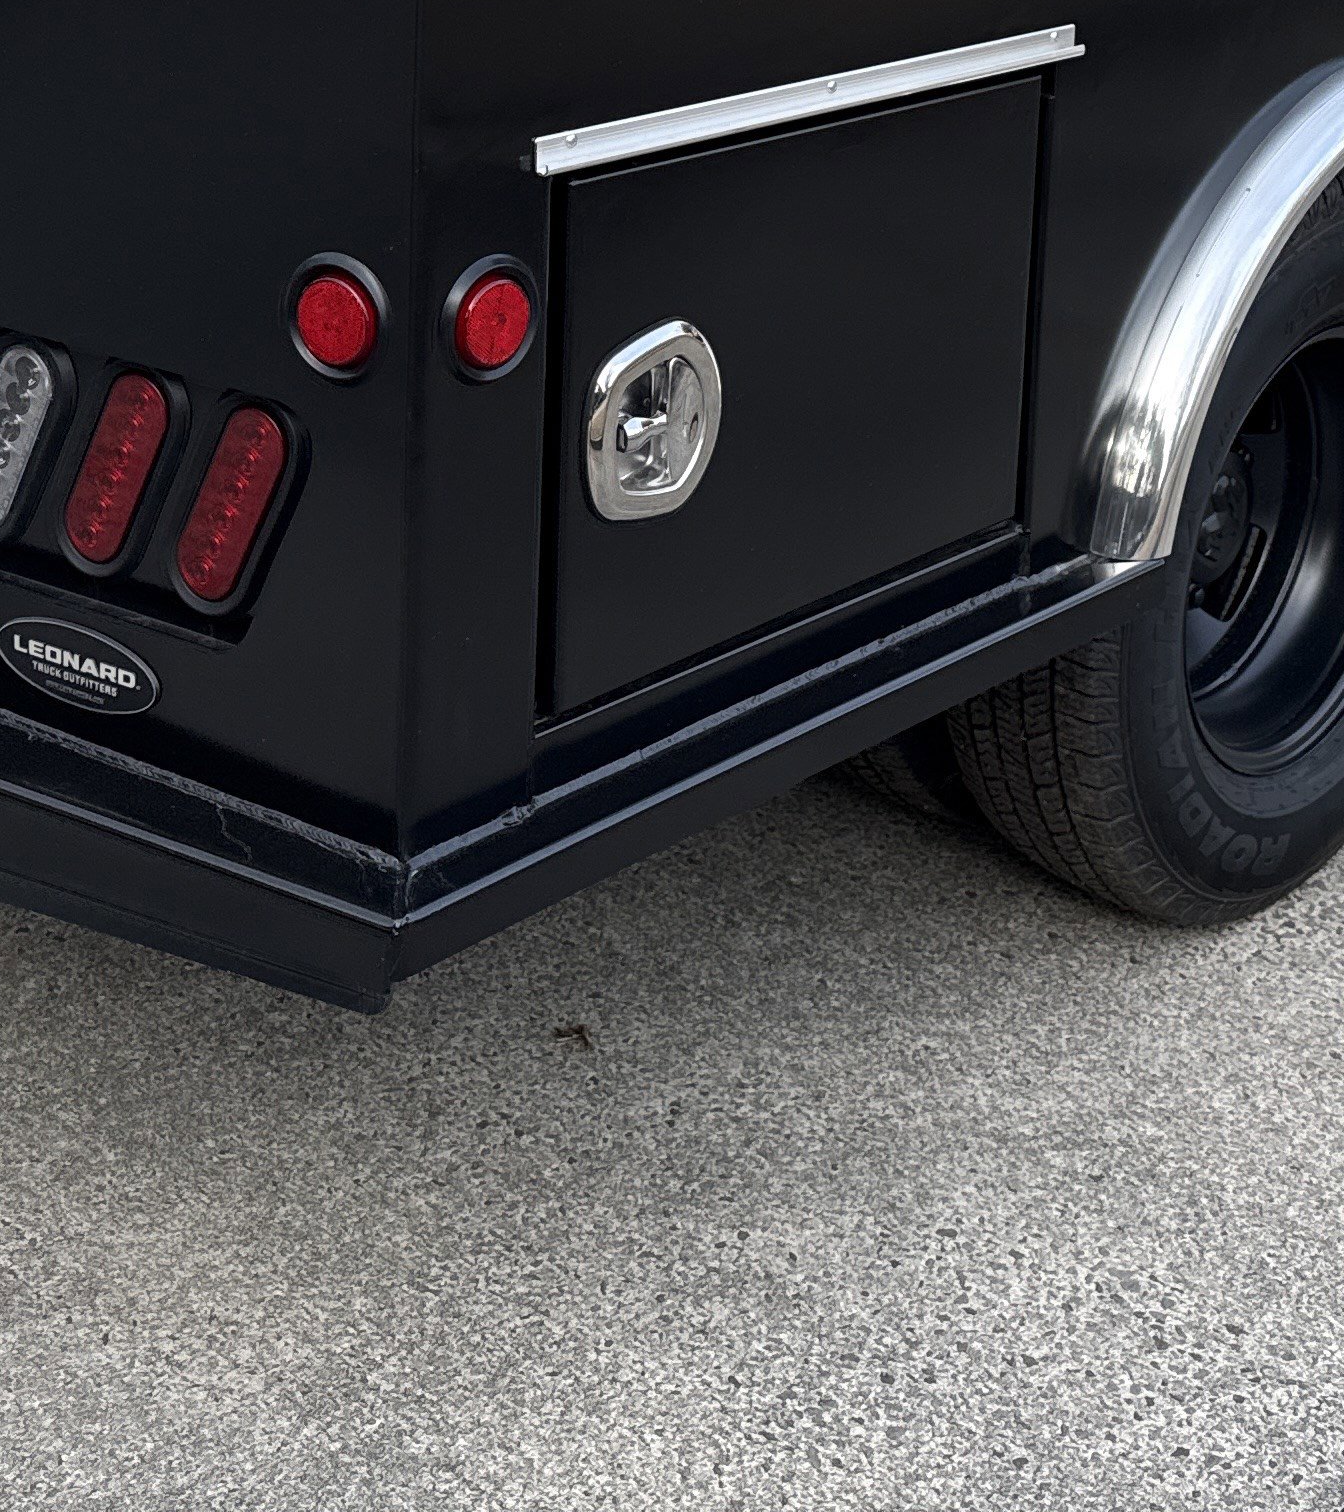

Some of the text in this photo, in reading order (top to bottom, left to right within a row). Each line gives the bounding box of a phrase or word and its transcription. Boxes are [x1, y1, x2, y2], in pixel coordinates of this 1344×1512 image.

[13, 633, 137, 689] LEONARD
[31, 659, 62, 678] TRUCK
[62, 671, 119, 698] OUTFITTERS
